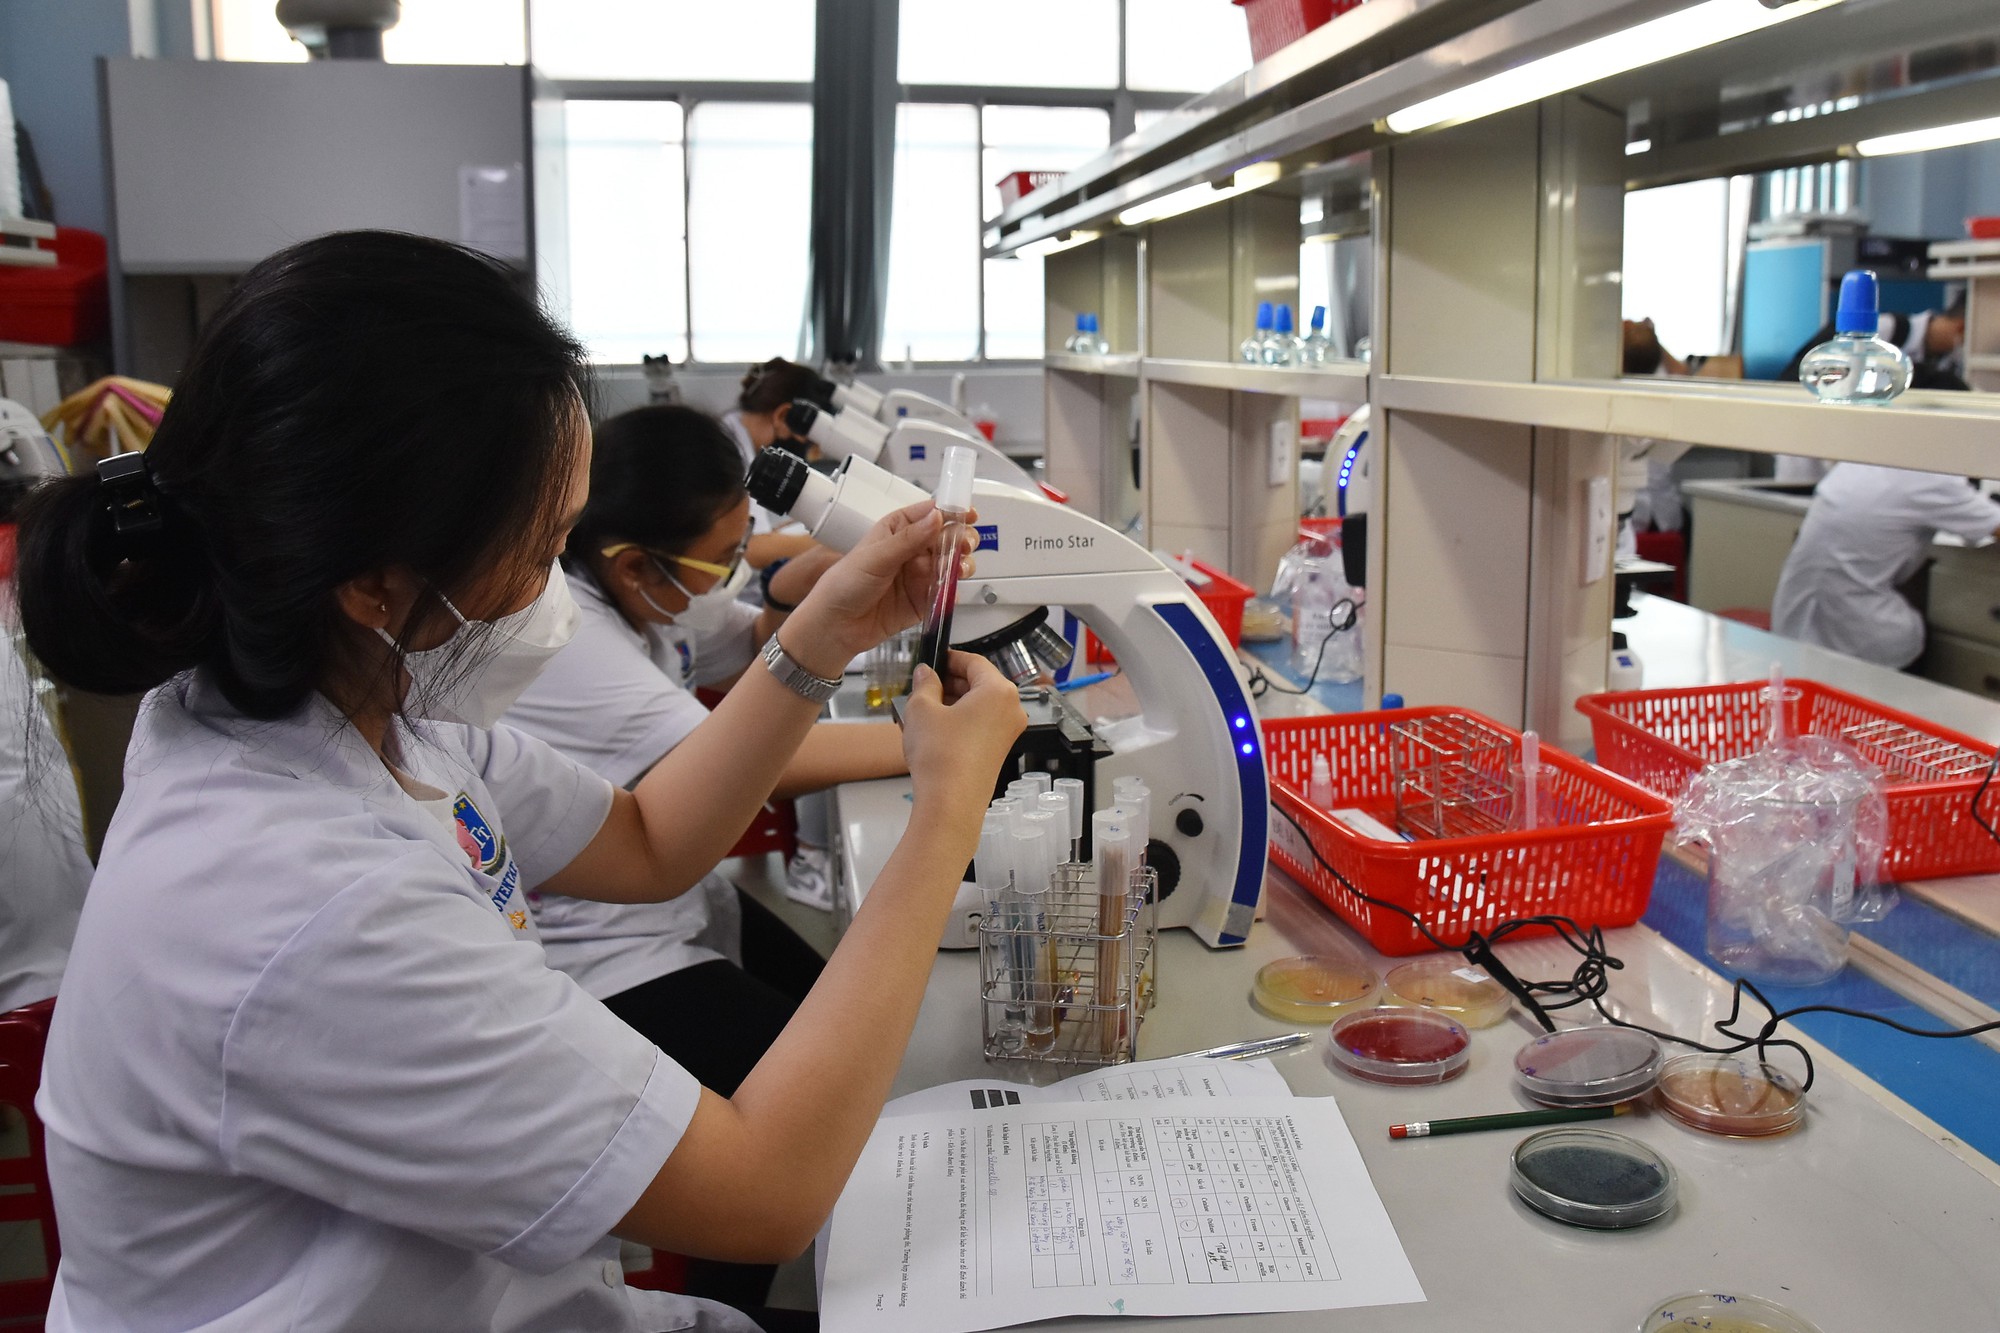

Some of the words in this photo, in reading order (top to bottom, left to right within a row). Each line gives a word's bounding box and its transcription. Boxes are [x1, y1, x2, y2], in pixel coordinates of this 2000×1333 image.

[1025, 537, 1063, 550] Primo
[1068, 536, 1094, 548] Star
[876, 1294, 884, 1307] Trang
